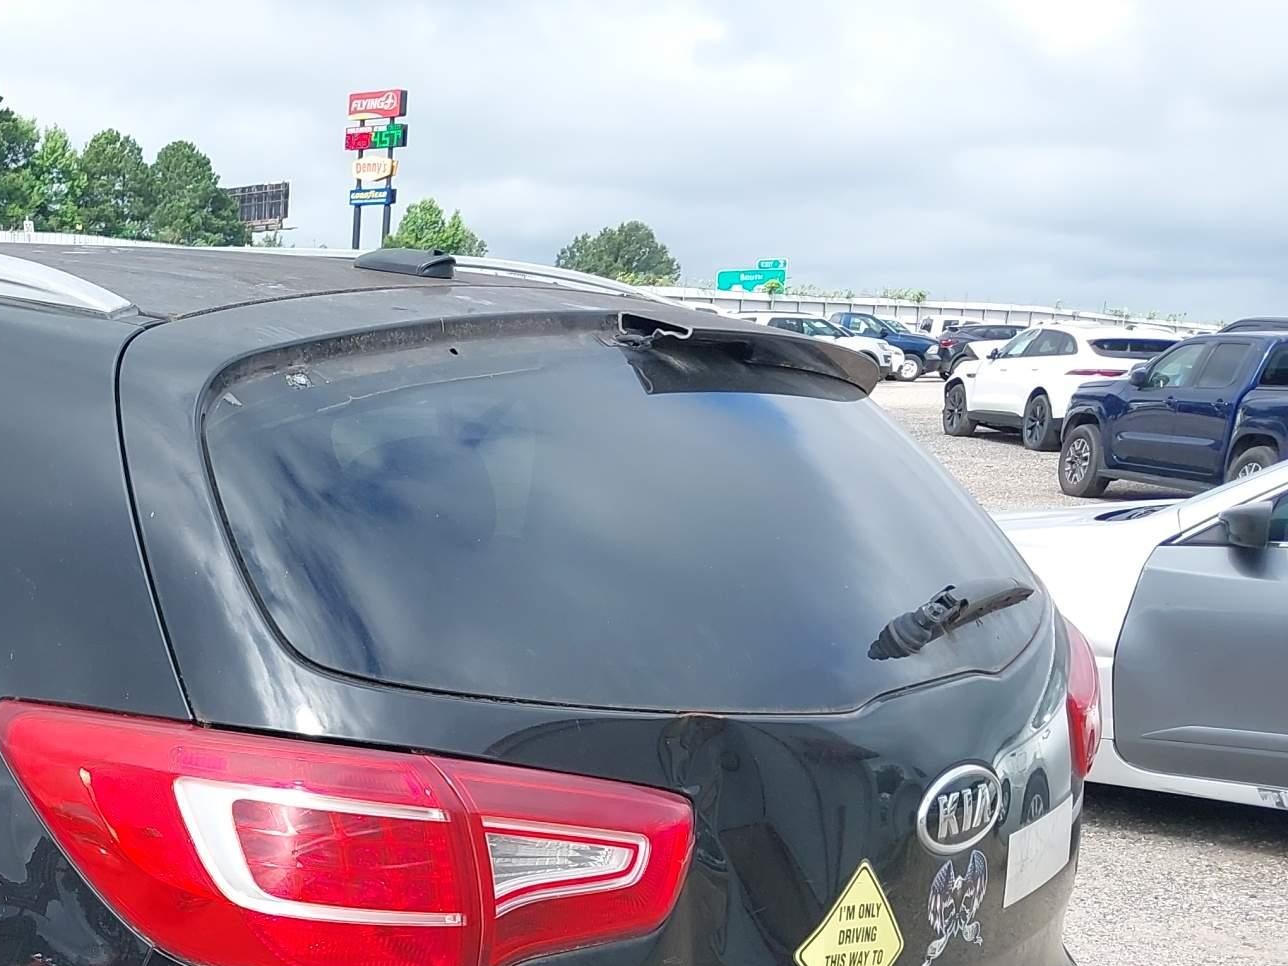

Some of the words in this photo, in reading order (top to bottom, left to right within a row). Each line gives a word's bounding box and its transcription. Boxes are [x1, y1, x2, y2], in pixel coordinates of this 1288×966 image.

[350, 97, 384, 111] FLYING
[355, 160, 388, 175] Denny's
[937, 782, 994, 841] KIA
[838, 905, 855, 922] I'M
[858, 902, 882, 919] ONLY
[837, 925, 878, 946] DRIVING
[872, 949, 884, 966] TO
